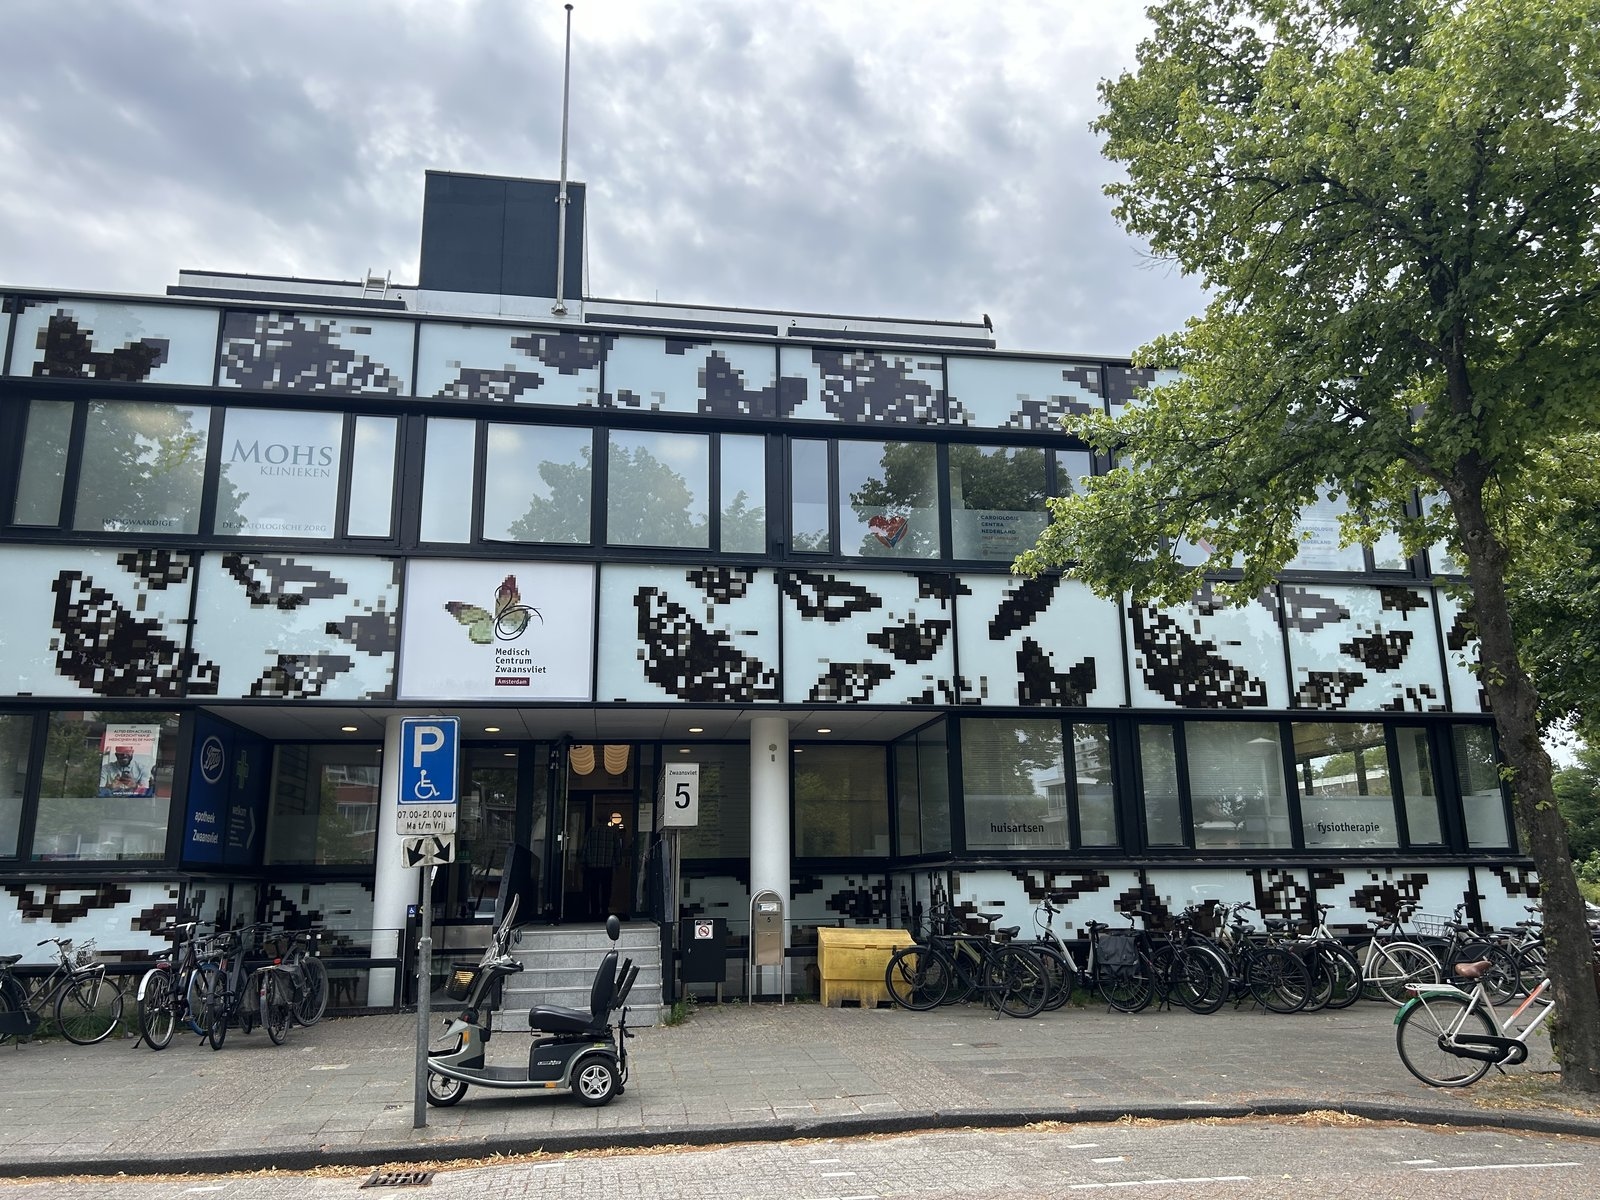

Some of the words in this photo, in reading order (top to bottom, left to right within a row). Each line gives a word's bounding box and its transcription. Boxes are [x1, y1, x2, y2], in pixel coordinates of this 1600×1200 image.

[230, 439, 333, 467] MOHS
[260, 466, 330, 478] KLINIEKEN
[222, 521, 302, 532] DERMATOLOGISCHE
[304, 524, 327, 532] ZORG
[495, 648, 530, 656] Medisch
[495, 656, 532, 664] Centrum
[495, 665, 546, 673] Zwaansvliet
[413, 726, 445, 768] P
[674, 782, 690, 809] 5
[194, 811, 216, 824] apotheek
[397, 810, 442, 819] 07.00-21.00
[443, 810, 456, 818] uur
[406, 822, 416, 830] Ma
[417, 821, 432, 830] t/m
[433, 821, 446, 831] Vrij
[990, 822, 1045, 833] huisartsen
[1317, 822, 1380, 835] fysiotherapie
[192, 829, 219, 844] Zwaansvliet
